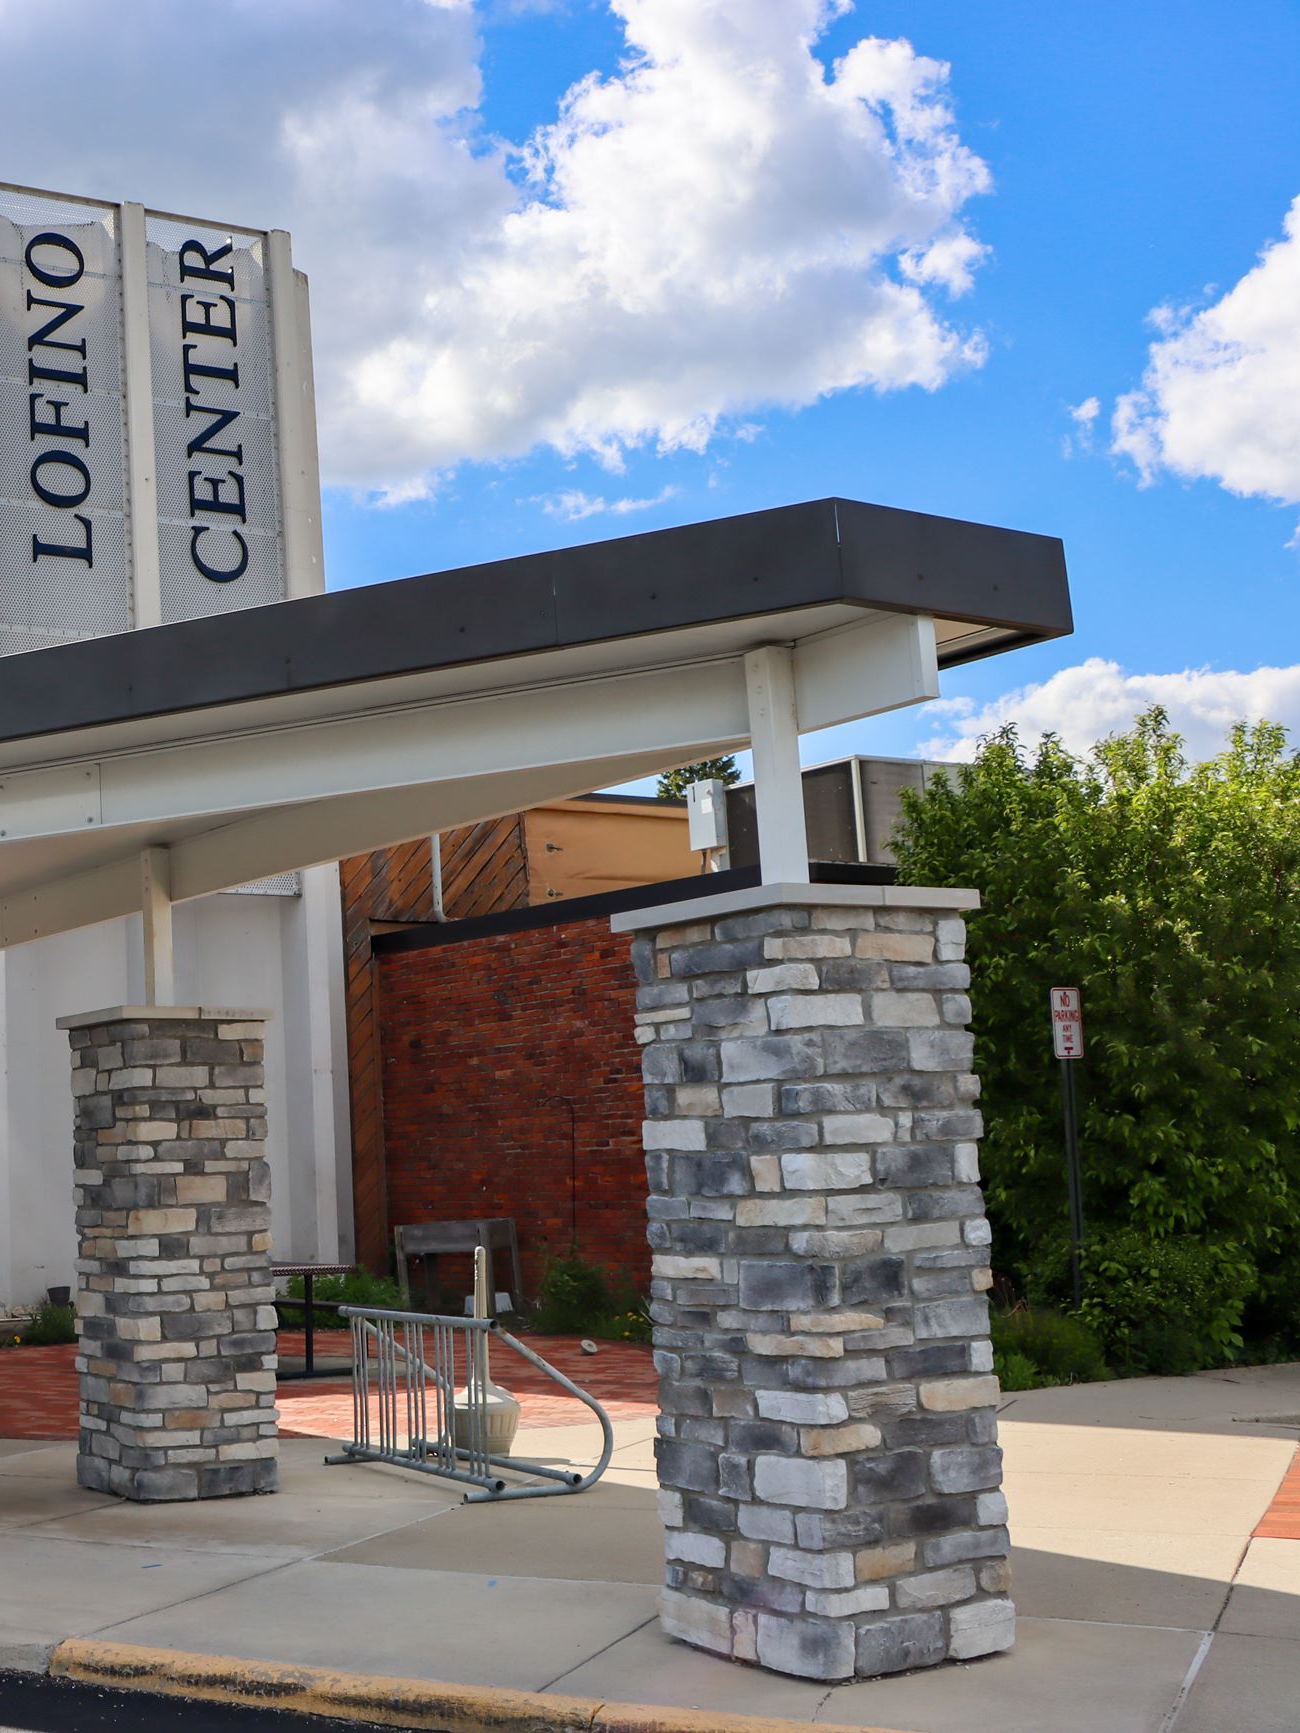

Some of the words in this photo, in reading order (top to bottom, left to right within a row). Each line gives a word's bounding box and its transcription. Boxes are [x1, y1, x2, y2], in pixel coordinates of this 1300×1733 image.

[25, 232, 93, 568] LOFINO
[179, 236, 249, 583] CENTER
[1060, 995, 1070, 1007] NO
[1054, 1010, 1079, 1022] PARKING
[1062, 1024, 1072, 1033] ANY
[1062, 1034, 1074, 1043] TIME
